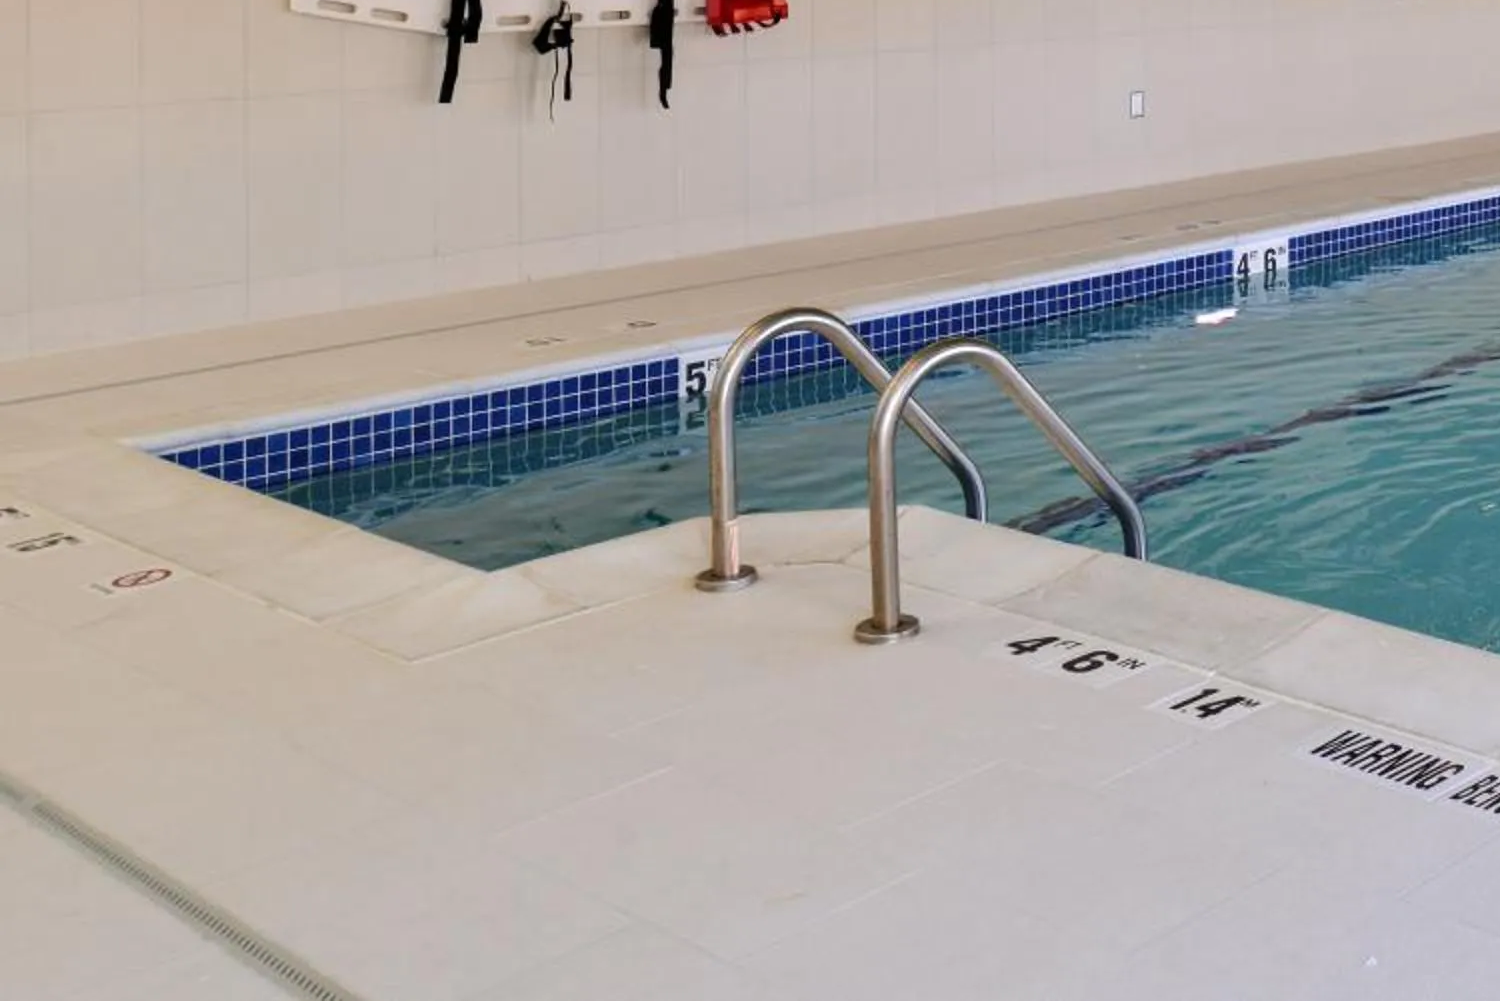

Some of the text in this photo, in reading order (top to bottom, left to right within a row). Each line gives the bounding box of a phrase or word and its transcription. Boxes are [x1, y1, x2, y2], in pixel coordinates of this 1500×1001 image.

[1237, 252, 1250, 277] 4
[1264, 247, 1277, 274] 6
[686, 360, 707, 396] 5
[1008, 635, 1060, 656] 4
[1061, 650, 1120, 674] 6
[1311, 729, 1466, 791] WARNING
